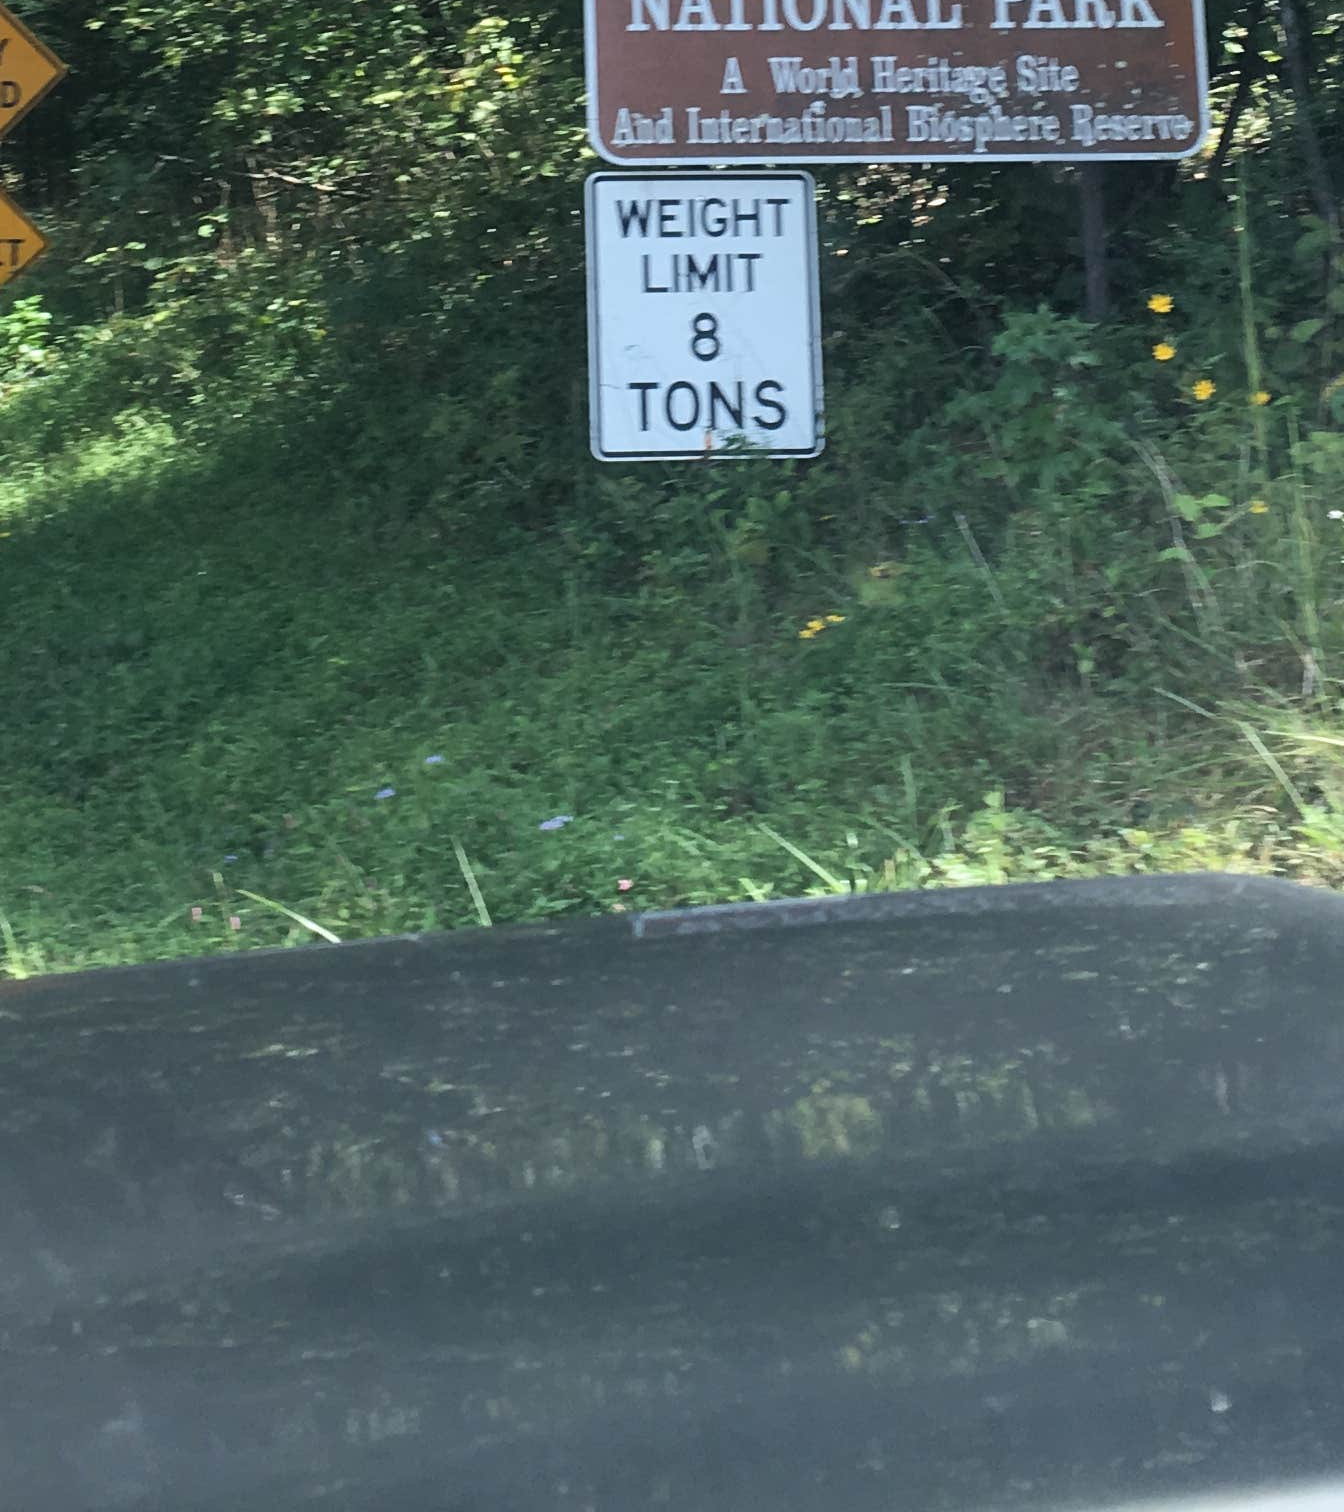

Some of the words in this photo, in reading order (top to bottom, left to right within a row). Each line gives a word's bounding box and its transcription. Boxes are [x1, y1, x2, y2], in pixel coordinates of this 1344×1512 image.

[720, 57, 747, 94] A
[768, 56, 857, 97] World
[870, 56, 1007, 104] Heritage
[1016, 54, 1080, 92] Site
[611, 107, 674, 146] And
[686, 101, 894, 145] International
[906, 105, 1060, 152] Biosphere
[1070, 104, 1193, 147] Reserve
[616, 198, 791, 238] WEIGHT
[642, 253, 763, 293] LIMIT
[691, 312, 720, 362] 8
[628, 379, 787, 431] TONS
